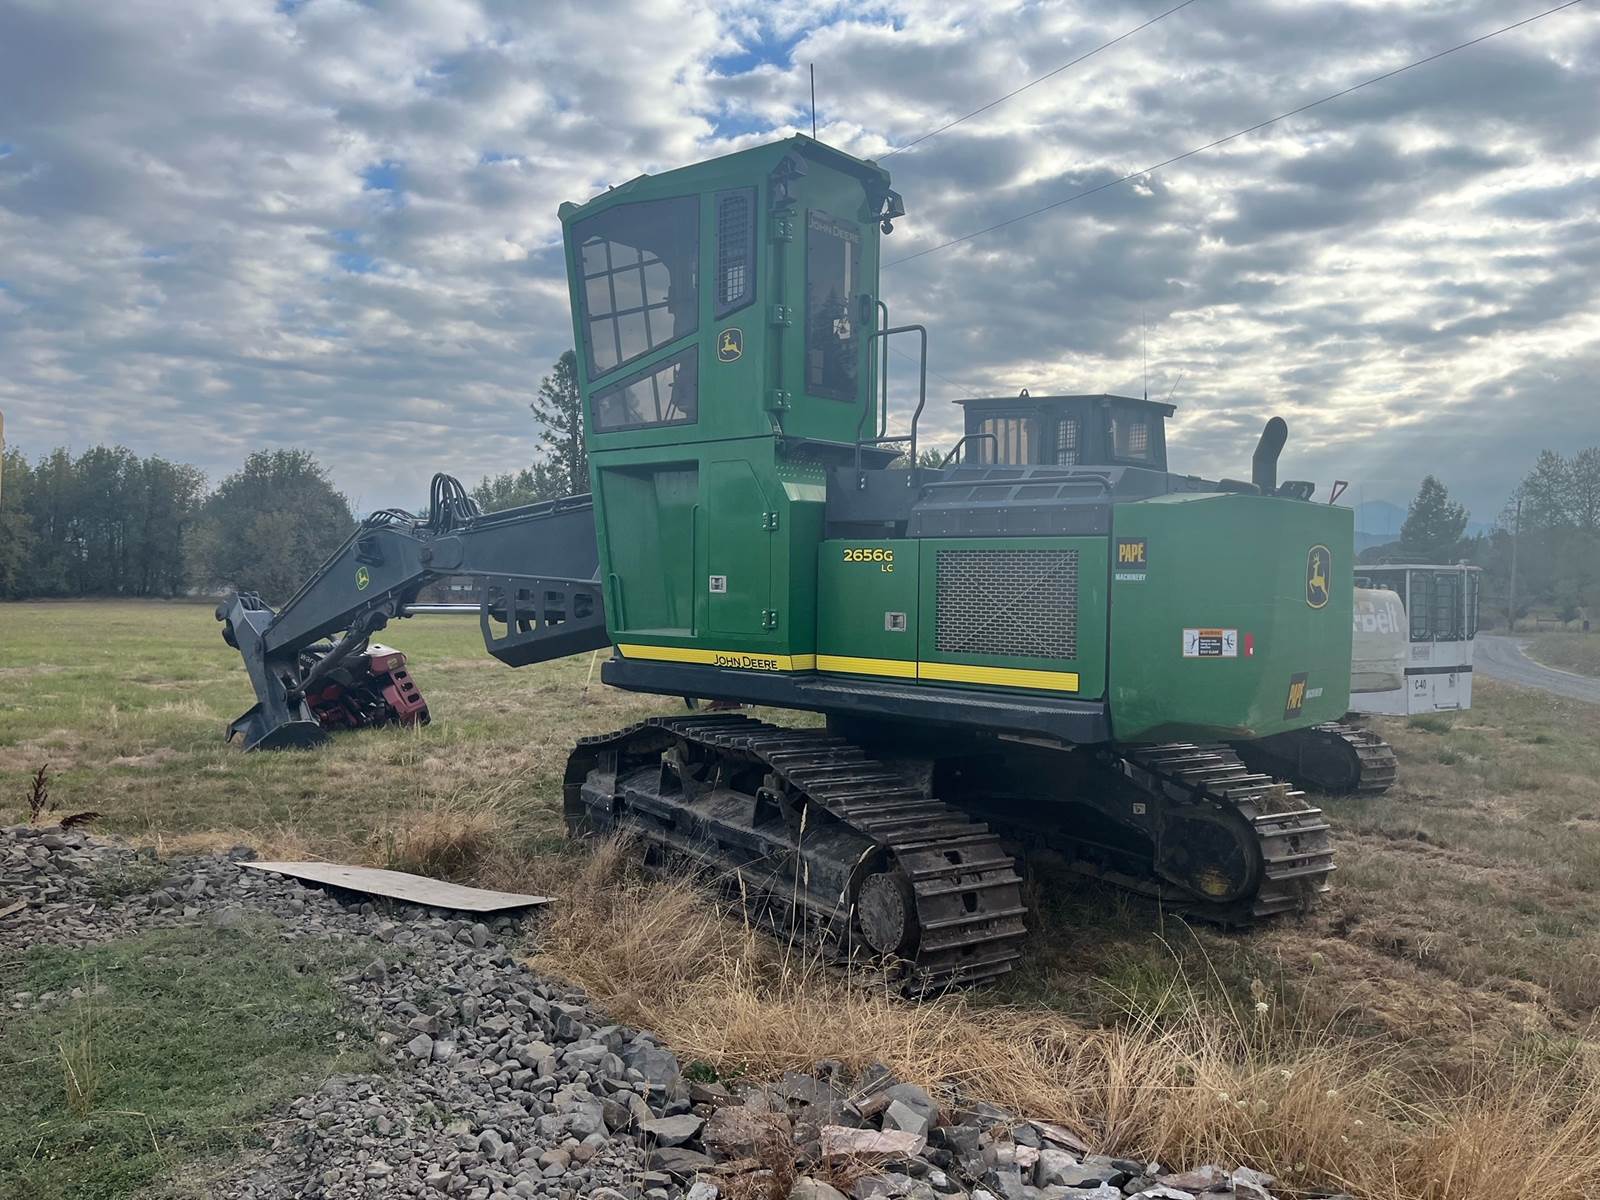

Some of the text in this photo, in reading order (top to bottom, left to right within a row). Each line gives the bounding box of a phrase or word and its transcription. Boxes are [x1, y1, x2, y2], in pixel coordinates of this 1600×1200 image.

[843, 548, 893, 562] 2656G
[881, 564, 893, 572] LC
[713, 653, 779, 671] JOHN DEERE
